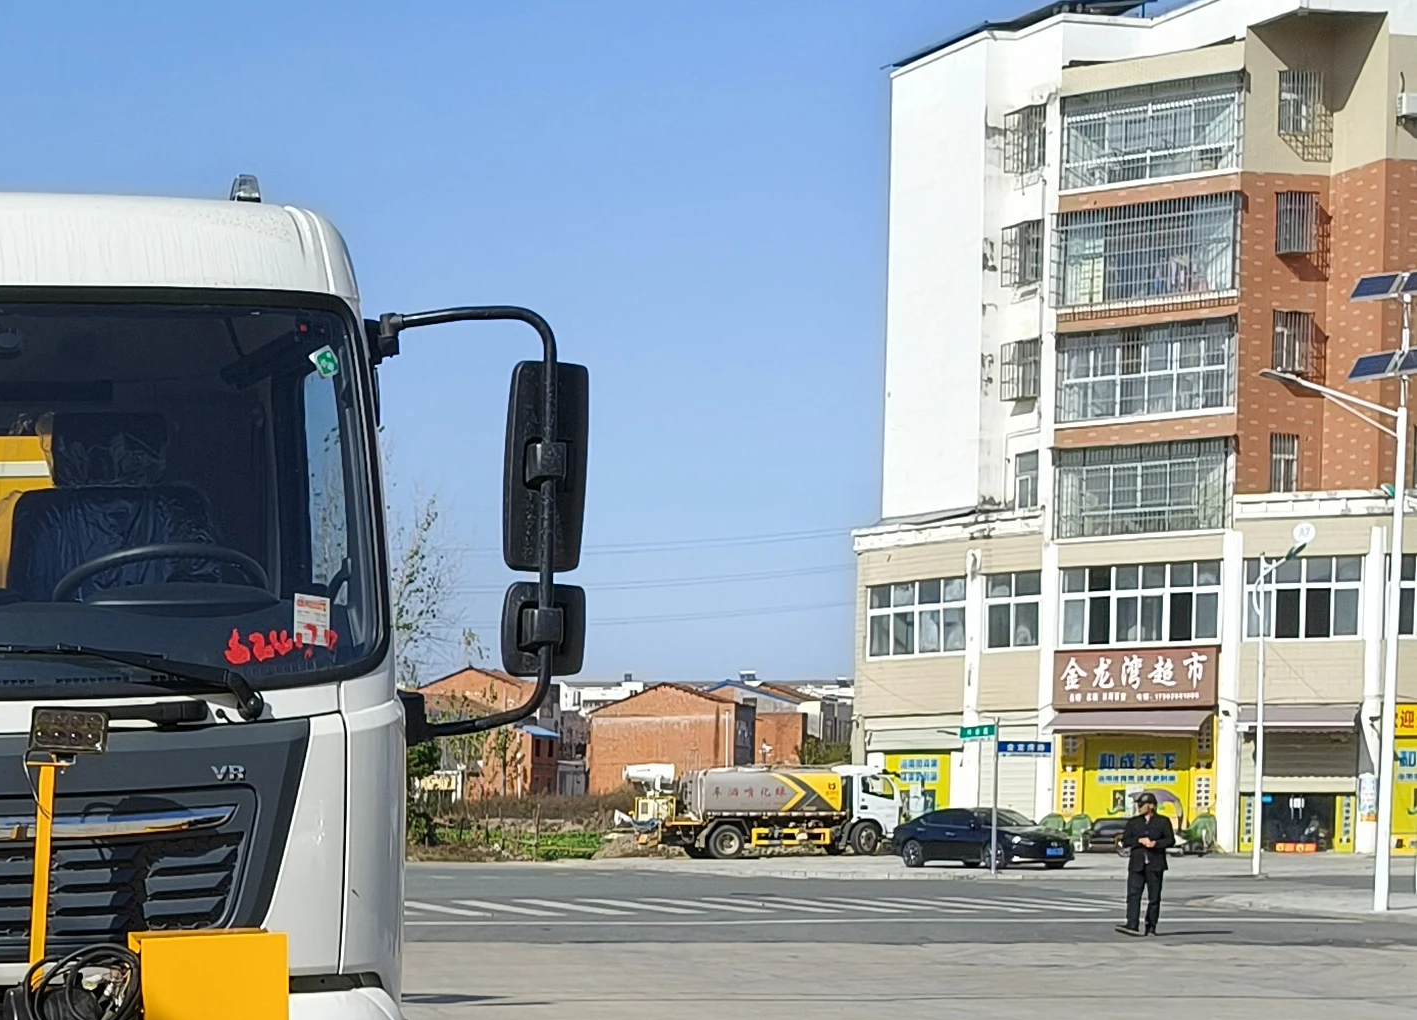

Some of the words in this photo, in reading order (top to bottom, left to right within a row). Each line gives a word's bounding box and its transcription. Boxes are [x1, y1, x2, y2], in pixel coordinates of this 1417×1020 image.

[1060, 651, 1208, 691] 金龙湾超市
[1099, 752, 1177, 770] 和成天下
[210, 764, 245, 780] VR
